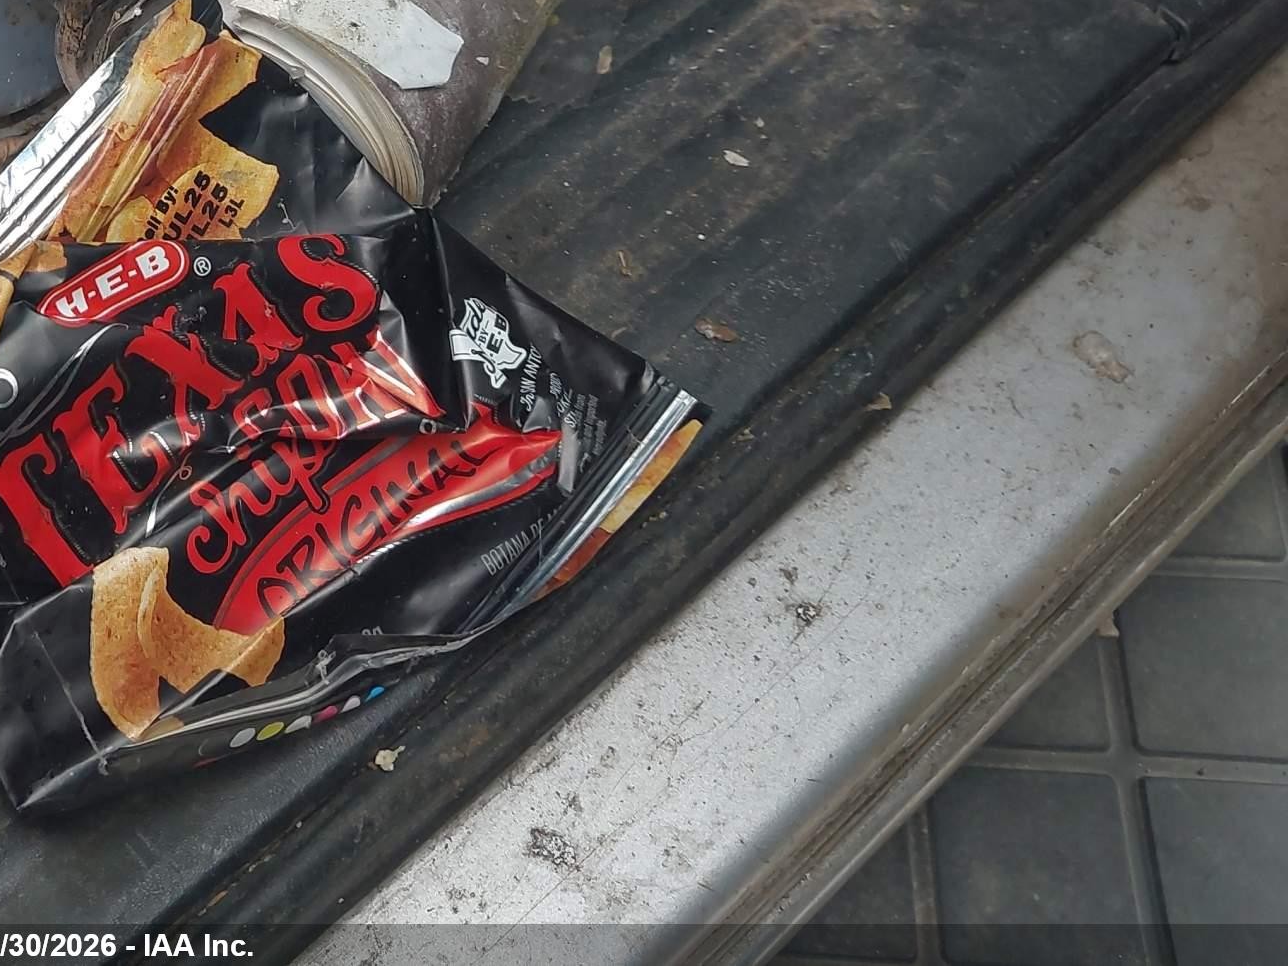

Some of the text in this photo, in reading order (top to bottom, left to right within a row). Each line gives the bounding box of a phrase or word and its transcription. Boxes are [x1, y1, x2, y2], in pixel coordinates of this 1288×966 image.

[138, 215, 163, 241] ell
[218, 197, 245, 229] L3L
[55, 246, 171, 318] H-E-B
[478, 327, 489, 345] BY
[527, 345, 543, 376] ANTO
[520, 372, 541, 397] SAN
[257, 439, 502, 619] ORIGINAL
[480, 535, 528, 576] BOTANA
